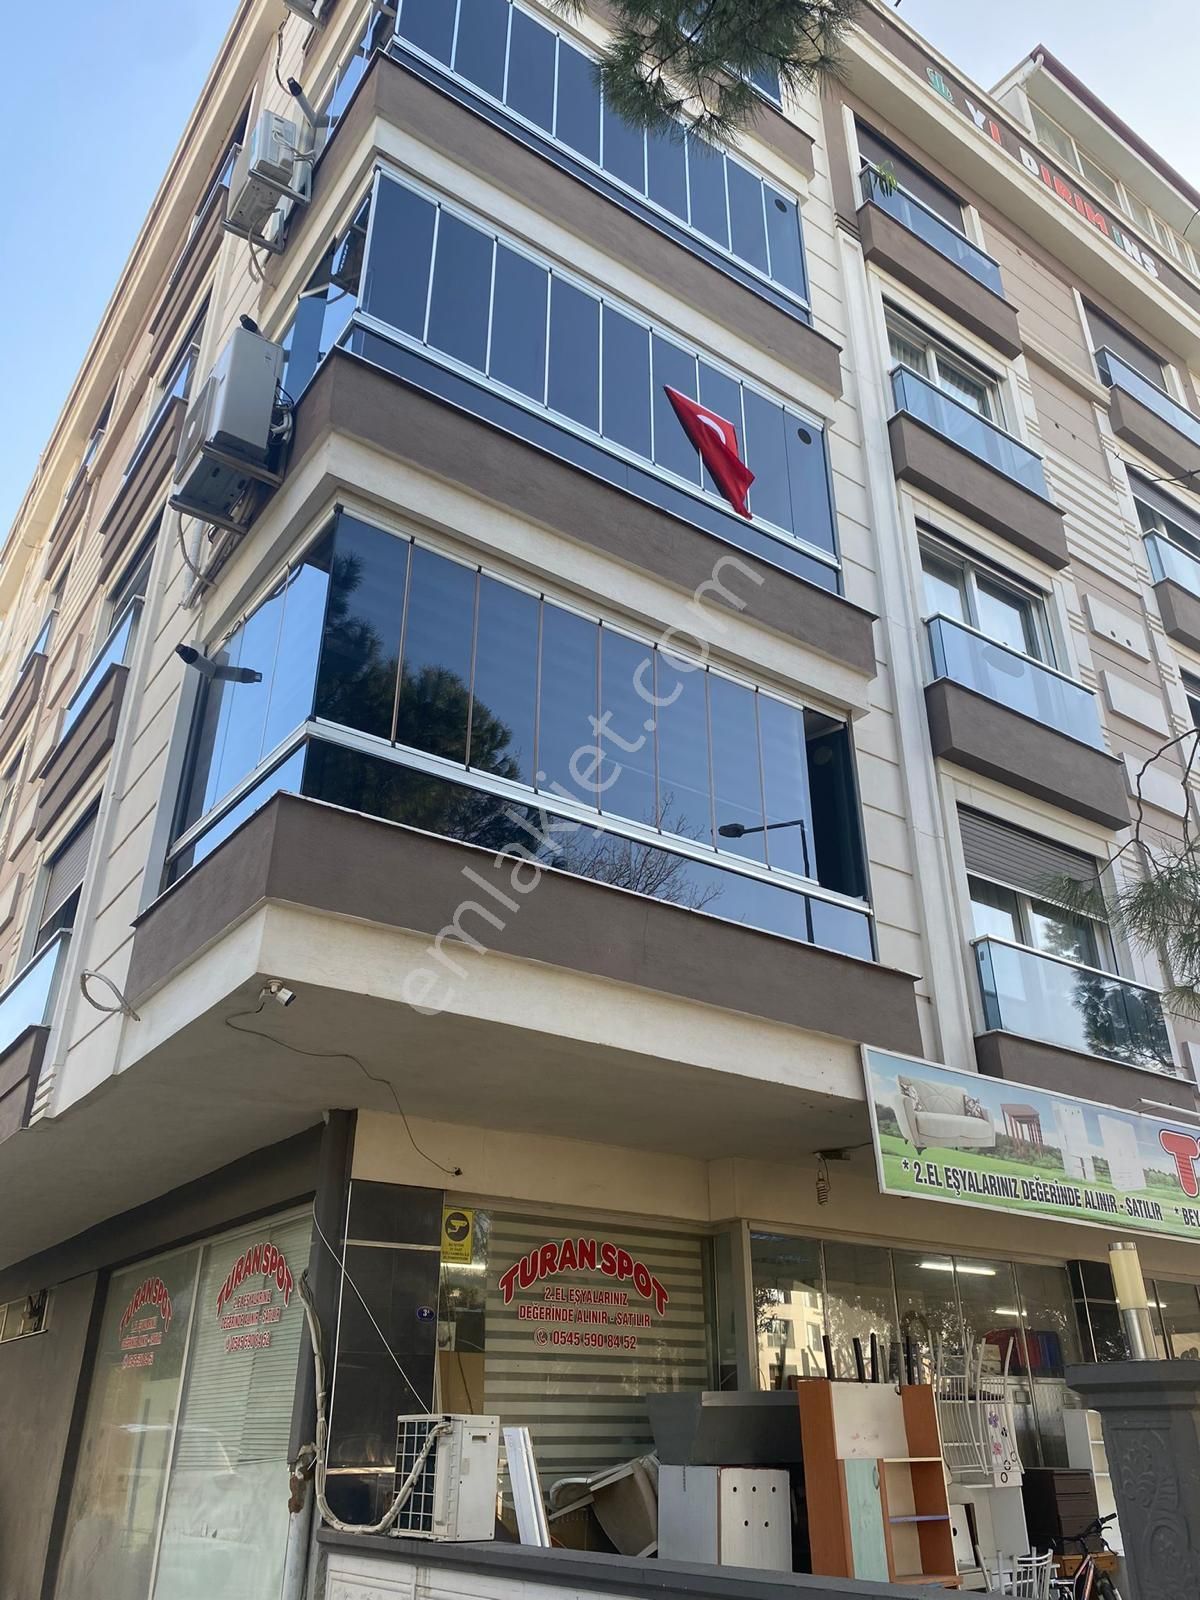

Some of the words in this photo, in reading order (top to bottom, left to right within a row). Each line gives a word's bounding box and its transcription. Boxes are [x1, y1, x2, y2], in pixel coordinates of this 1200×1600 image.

[1158, 1128, 1200, 1199] T
[913, 1160, 943, 1187] 2.EL
[944, 1166, 1020, 1196] EŞYALARINIZ
[1021, 1176, 1082, 1208] DEĞERİNDE
[1084, 1189, 1118, 1214] ALINIR
[1125, 1196, 1164, 1221] SATILIR
[499, 1238, 597, 1305] TURAN
[600, 1243, 669, 1317] SPOT
[544, 1287, 566, 1302] 2.EL
[568, 1289, 628, 1307] EŞYALARINIZ
[519, 1303, 574, 1322] DEĞERİNDE
[576, 1310, 608, 1325] ALINIR
[616, 1314, 651, 1328] SATILIR
[553, 1330, 580, 1346] 0545
[584, 1332, 604, 1347] 590
[607, 1334, 620, 1349] 84
[624, 1335, 637, 1350] 52
